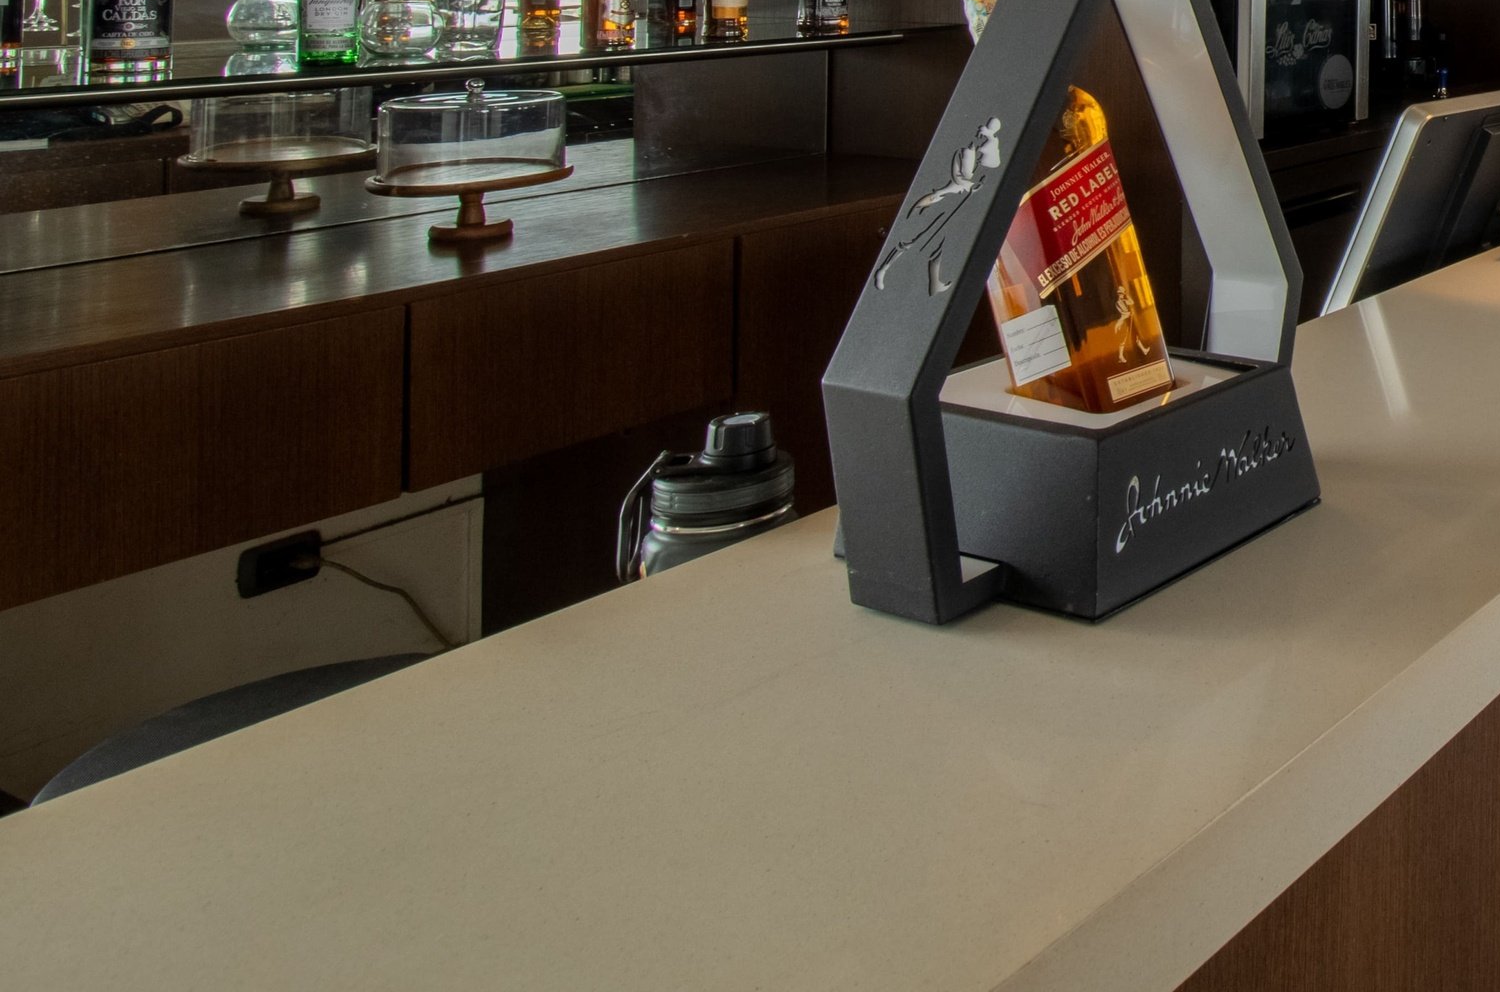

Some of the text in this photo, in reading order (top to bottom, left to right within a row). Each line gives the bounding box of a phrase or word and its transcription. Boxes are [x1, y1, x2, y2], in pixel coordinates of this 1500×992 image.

[1049, 192, 1079, 220] RED
[1080, 163, 1118, 196] LABEL
[1050, 171, 1083, 201] JOHNNIE
[1116, 425, 1296, 554] Johnnie Walker
